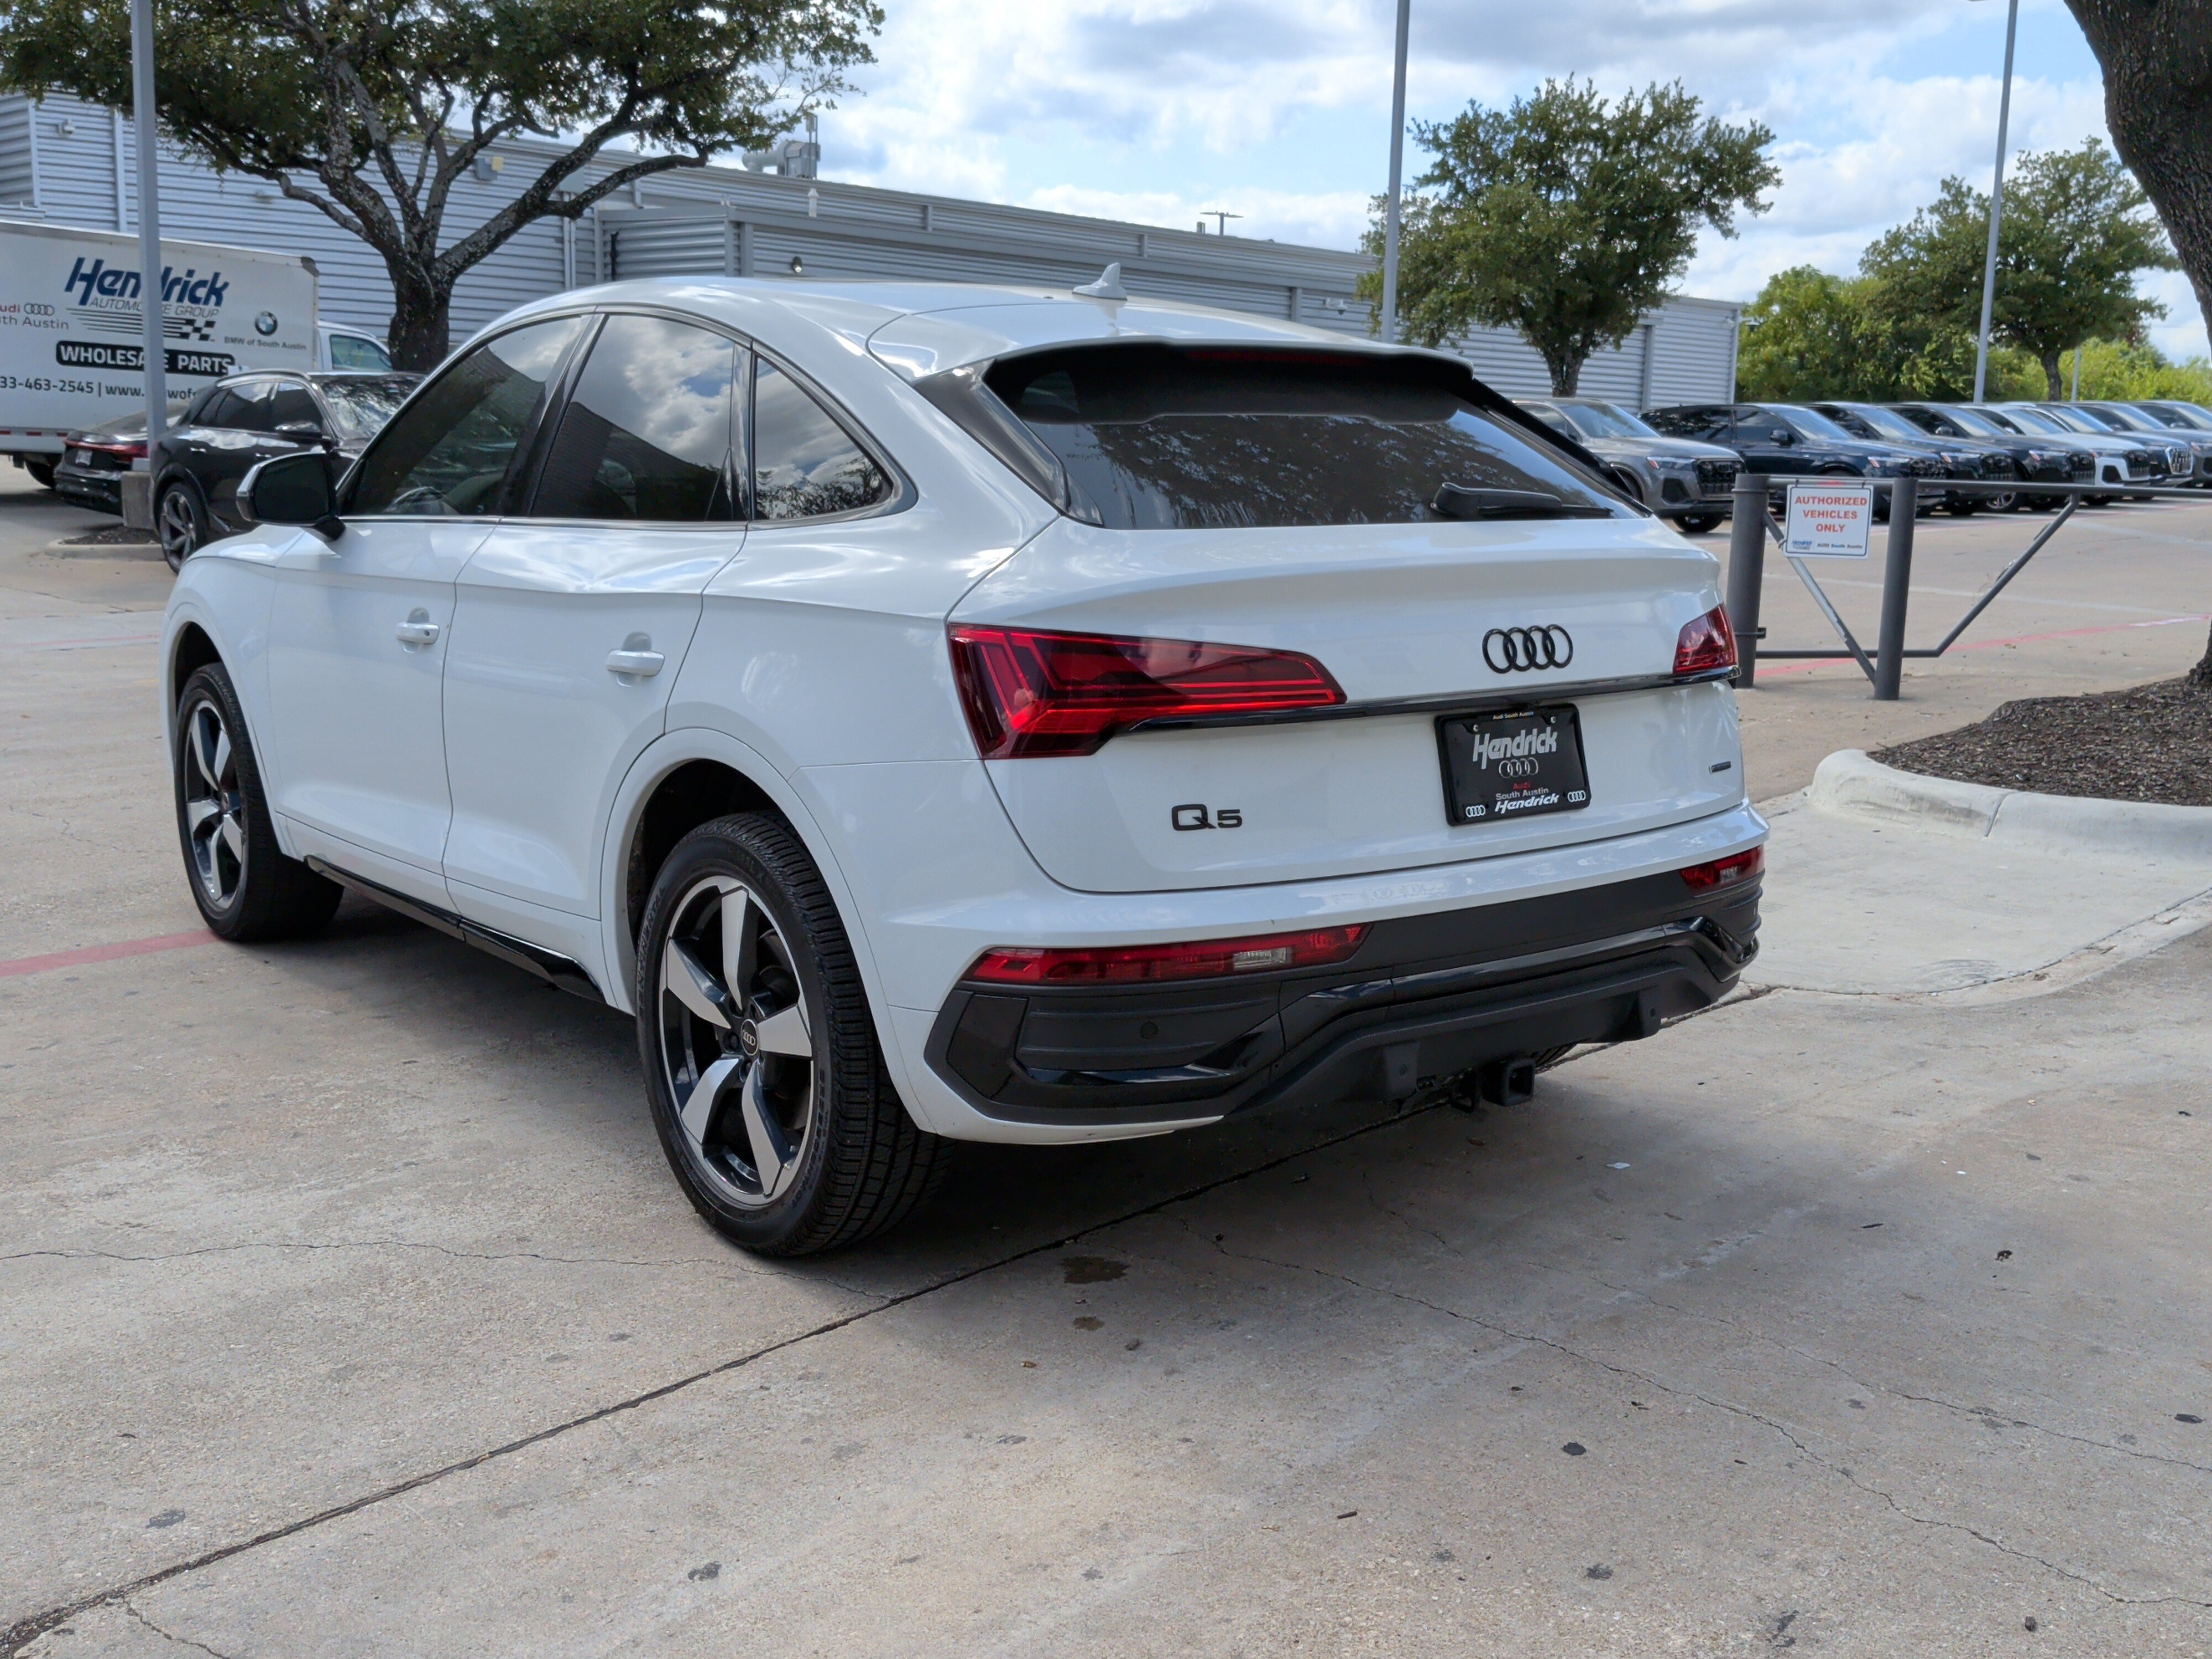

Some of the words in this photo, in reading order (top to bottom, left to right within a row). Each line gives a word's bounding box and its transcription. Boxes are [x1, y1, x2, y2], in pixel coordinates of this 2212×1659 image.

[0, 304, 20, 313] udi
[89, 297, 171, 315] AUTOME
[175, 305, 220, 318] GROUP
[23, 316, 69, 330] Austin
[224, 336, 246, 345] BMW
[257, 339, 280, 348] South
[281, 342, 306, 350] Austin
[60, 345, 169, 369] WHOLESAE
[178, 354, 232, 373] PARTS
[0, 376, 93, 394] 33-463-2545
[1795, 495, 1867, 506] AUTHORIZED
[1803, 510, 1858, 520] VEHICLES
[1815, 524, 1846, 533] ONLY
[1472, 726, 1558, 770] Hendrick
[1513, 781, 1530, 790] Audi
[1496, 791, 1520, 800] South
[1522, 787, 1549, 797] Austin
[1495, 793, 1559, 814] Hendrick
[1171, 804, 1243, 831] Q5
